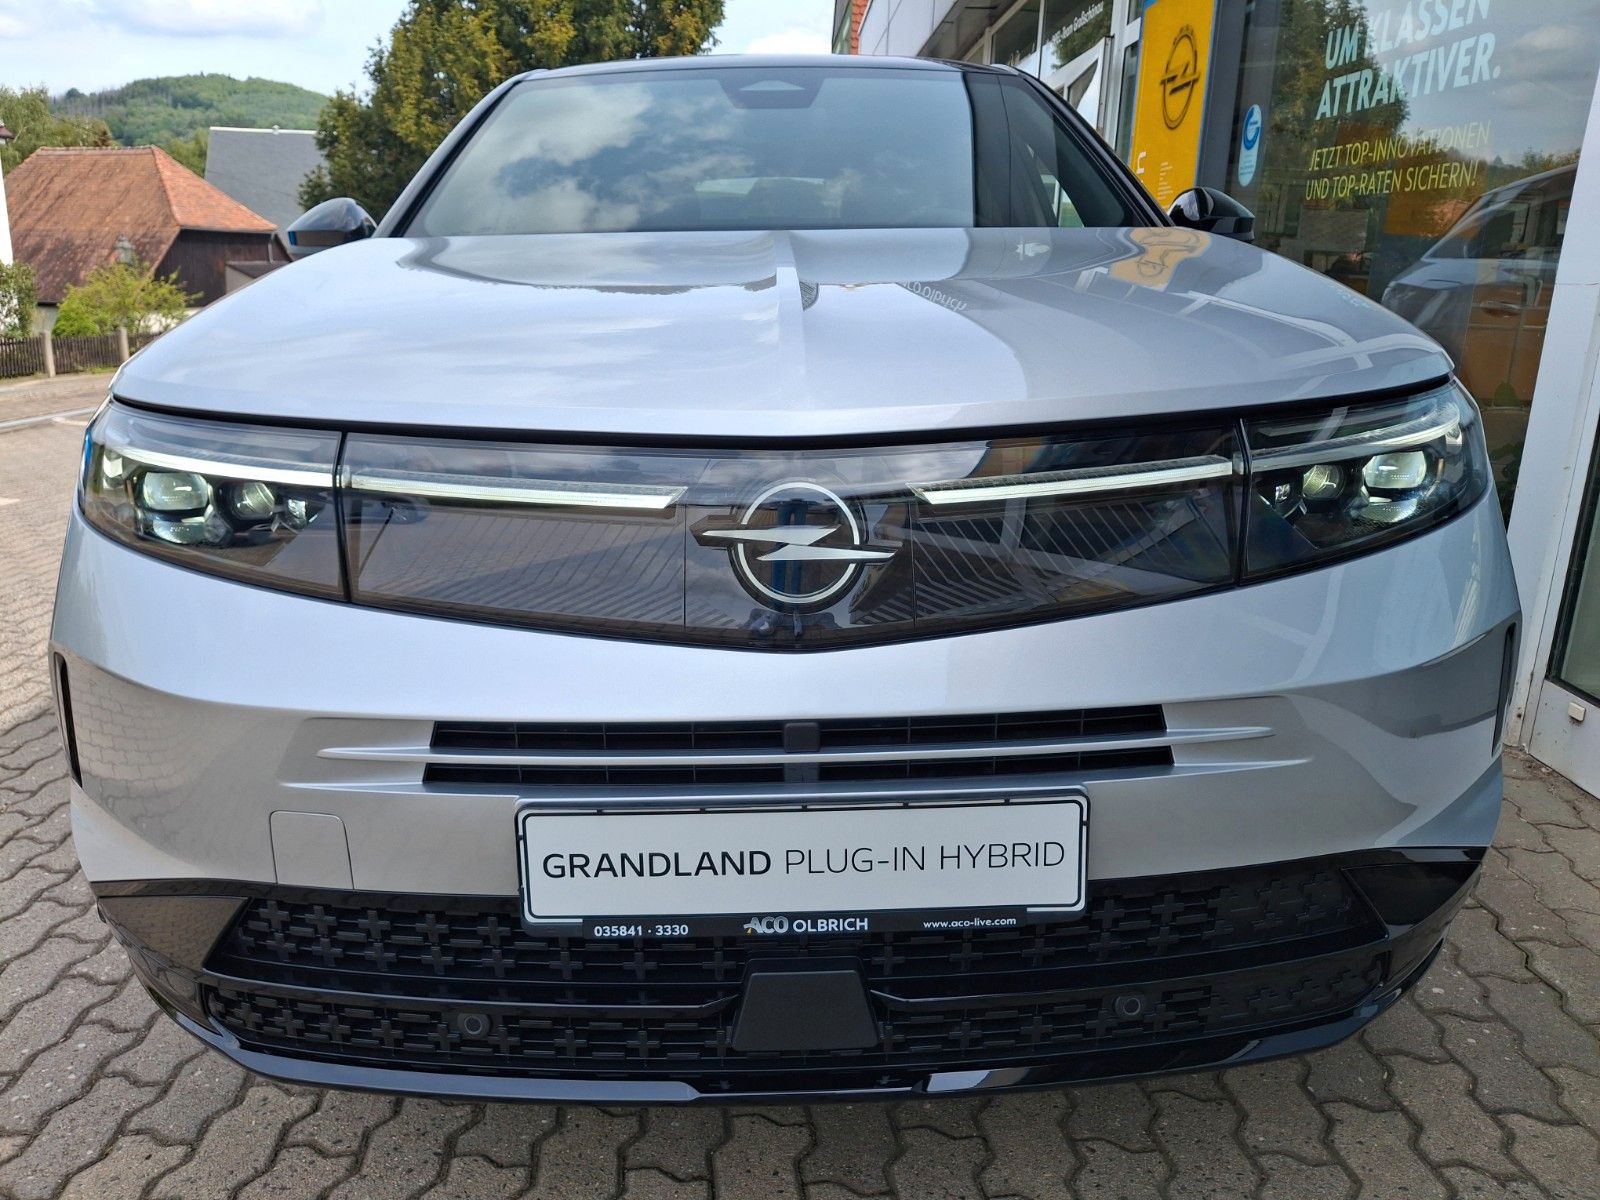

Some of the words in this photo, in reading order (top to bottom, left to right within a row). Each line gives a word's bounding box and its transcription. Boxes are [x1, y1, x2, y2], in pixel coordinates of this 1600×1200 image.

[1325, 24, 1360, 70] UM
[1364, 0, 1491, 58] KLASSEN
[1315, 32, 1501, 121] ATTRAKTIVER.
[1309, 145, 1343, 172] JETZT
[1345, 120, 1491, 166] TOP-INNOVATIONEN
[1305, 178, 1329, 200] UND
[1332, 169, 1403, 198] TOP-RATEN
[1404, 160, 1479, 192] SICHERN!
[542, 850, 771, 879] GRANDLAND
[785, 846, 925, 875] PLUG-IN
[939, 841, 1066, 871] HYBRID
[594, 925, 643, 937] 035841
[655, 924, 689, 936] 3330
[743, 916, 789, 934] ACO
[792, 917, 869, 934] OLBRICH
[923, 917, 1017, 929] www.aco-live.com
